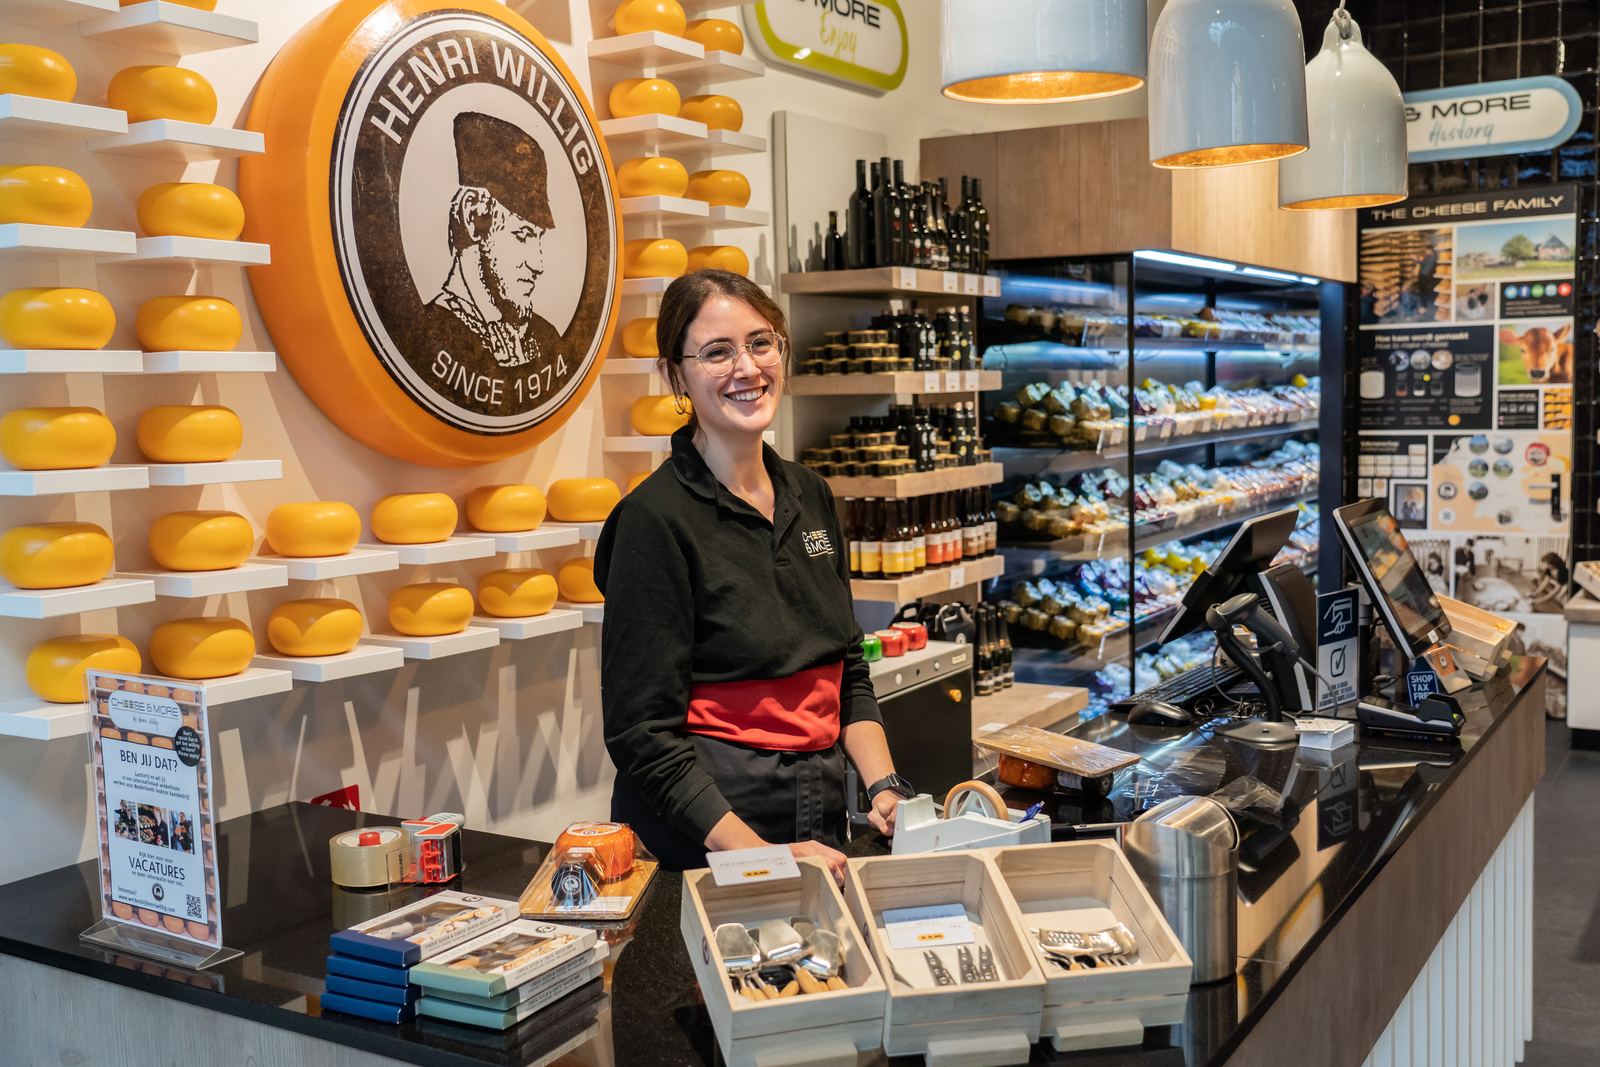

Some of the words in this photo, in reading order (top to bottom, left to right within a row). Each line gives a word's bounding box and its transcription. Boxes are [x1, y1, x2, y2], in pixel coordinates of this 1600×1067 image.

[820, 10, 858, 64] Enjoy
[370, 38, 479, 144] HENRI
[491, 40, 594, 175] WILLIG
[1432, 94, 1530, 118] MORE
[1428, 119, 1494, 147] History
[1371, 207, 1406, 222] THE
[1412, 202, 1488, 218] CHEESE
[1493, 195, 1564, 212] FAMILY
[432, 350, 504, 404] SINCE
[514, 354, 568, 403] 1974
[1410, 675, 1433, 683] SHOP
[1411, 684, 1429, 692] TAX
[111, 697, 146, 711] CHEESE
[147, 703, 152, 712] &
[153, 704, 178, 717] MORE
[120, 750, 137, 764] BEN
[141, 753, 151, 767] JIJ
[155, 756, 178, 772] DAT?
[128, 856, 185, 881] VACATURES
[147, 873, 166, 882] informatie
